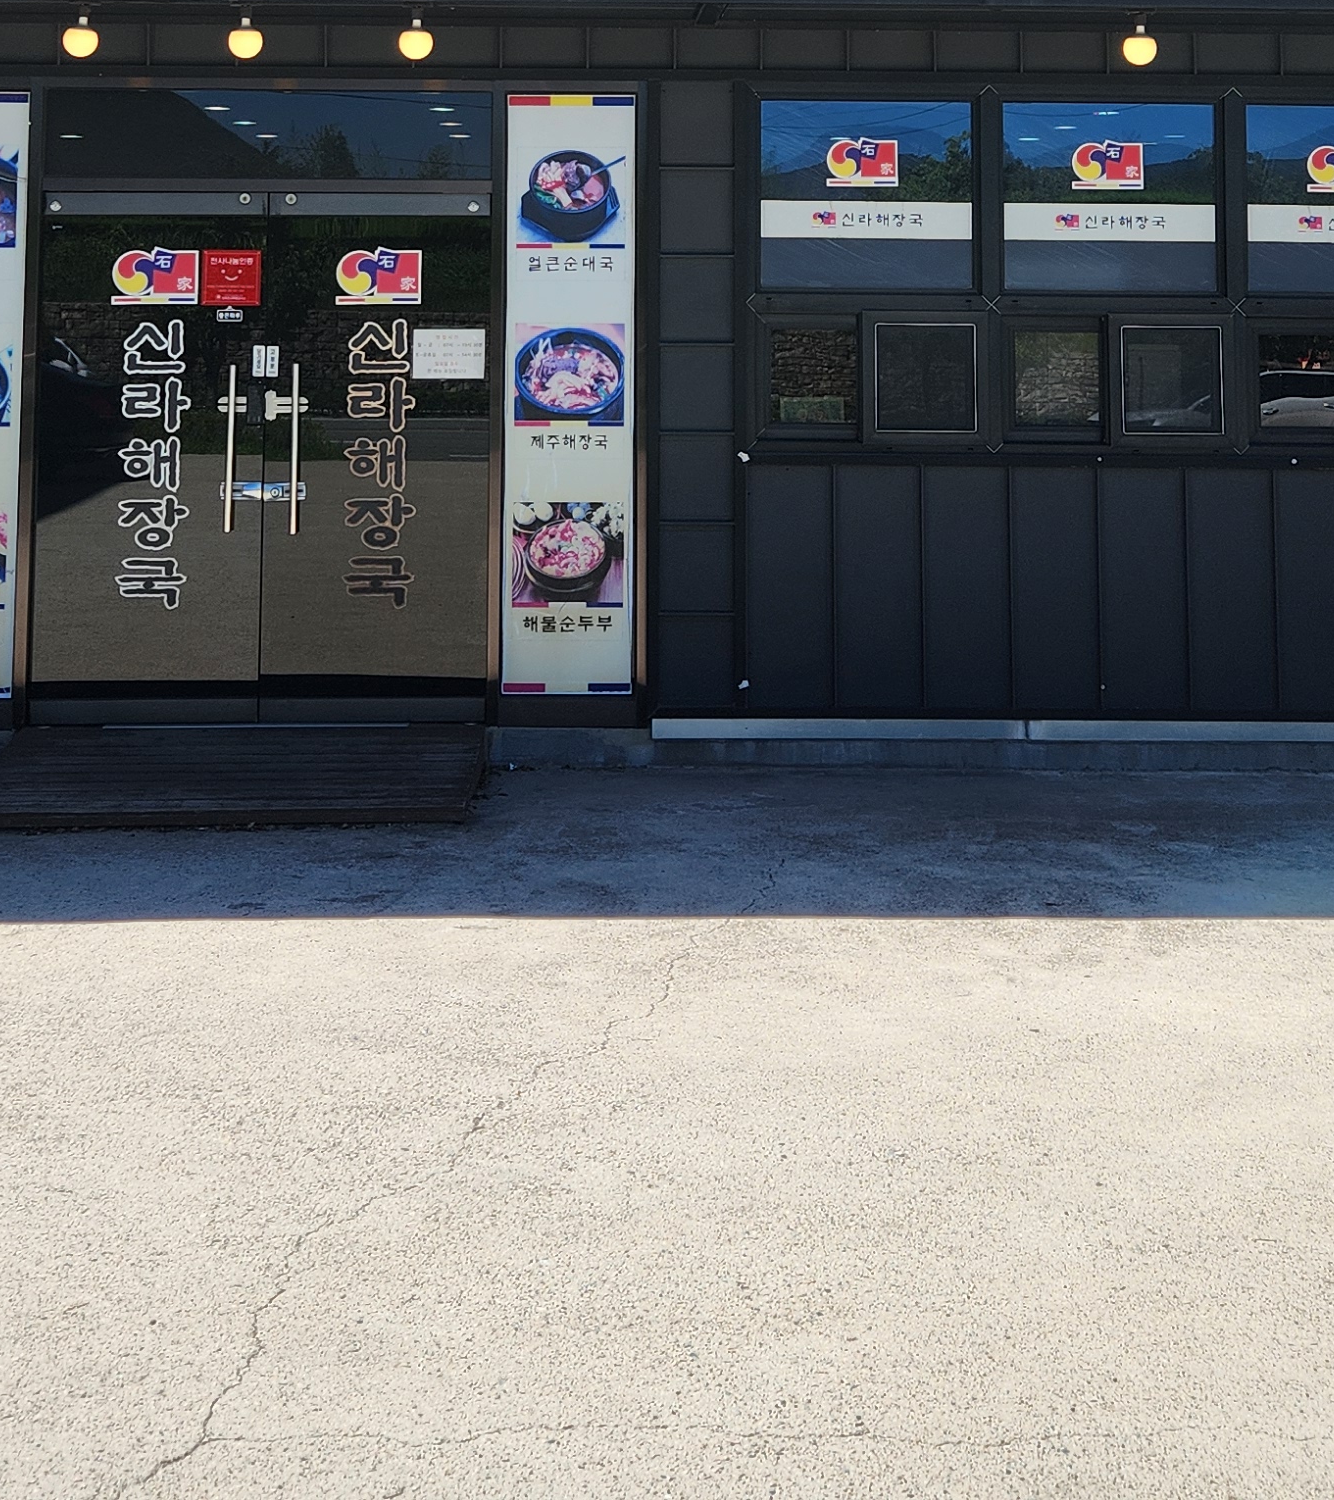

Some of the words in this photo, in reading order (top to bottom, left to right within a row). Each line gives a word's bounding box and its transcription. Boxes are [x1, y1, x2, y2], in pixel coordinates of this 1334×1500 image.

[842, 212, 924, 228] 신라해장국
[1085, 215, 1167, 230] 신라해장국
[528, 255, 614, 273] 얼큰순대국
[530, 433, 609, 451] 제주해장국
[115, 319, 192, 610] 신라해장국
[341, 318, 417, 609] 신라해장국
[522, 615, 613, 633] 해물순두부
